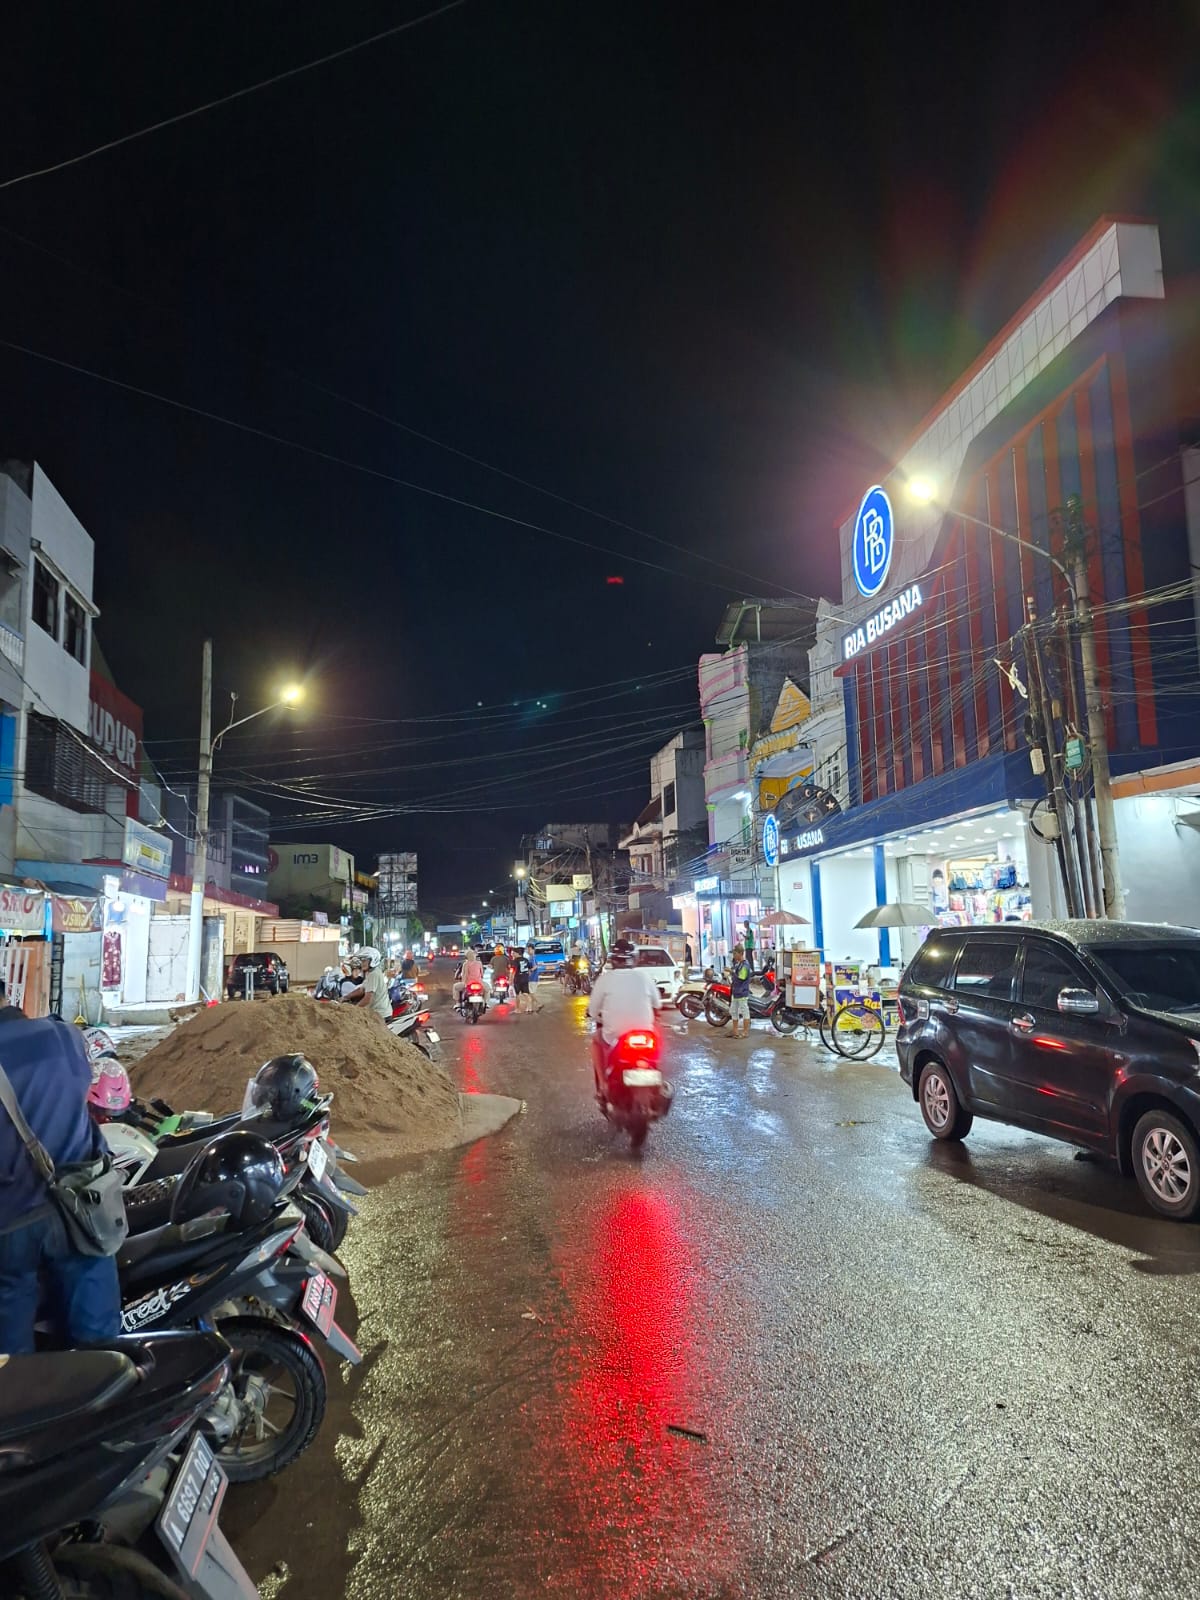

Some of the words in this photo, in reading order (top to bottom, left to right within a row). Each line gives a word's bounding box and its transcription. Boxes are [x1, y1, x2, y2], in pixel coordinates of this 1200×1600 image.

[844, 627, 867, 660] RIA
[866, 584, 923, 644] BUSANA
[794, 828, 824, 851] USANA
[293, 853, 319, 865] IM3
[119, 1287, 172, 1333] treet
[176, 1473, 201, 1524] 6697
[169, 1521, 185, 1544] A
